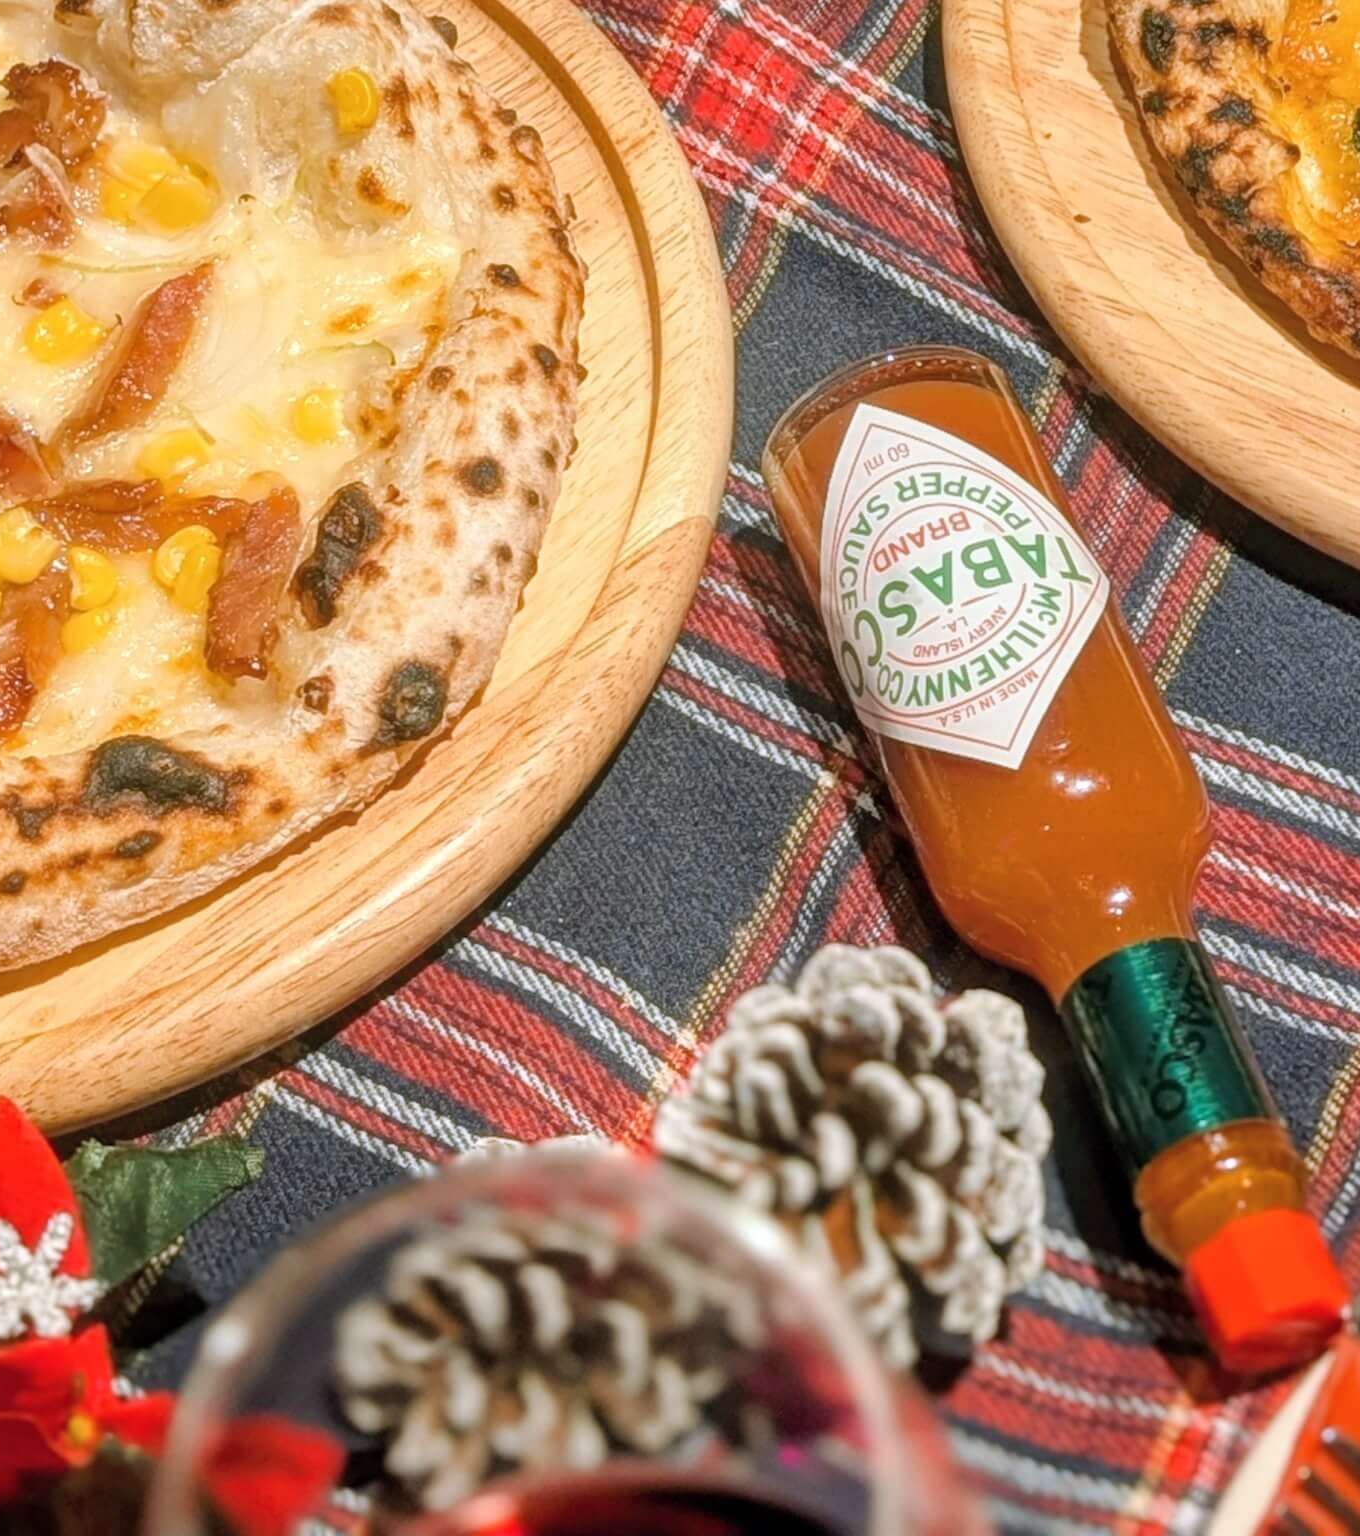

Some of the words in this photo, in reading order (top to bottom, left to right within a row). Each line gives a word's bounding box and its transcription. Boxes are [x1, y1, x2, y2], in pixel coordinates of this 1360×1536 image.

[863, 453, 885, 476] ml
[887, 443, 910, 463] 60
[893, 471, 1031, 531] PEPPER
[841, 494, 890, 615] SAUCE
[872, 510, 971, 573] BRAND
[841, 534, 1093, 699] TABASCO
[968, 605, 1008, 644] AVERY
[913, 637, 964, 658] ISLAND
[978, 695, 996, 712] IN
[999, 669, 1039, 702] MADE
